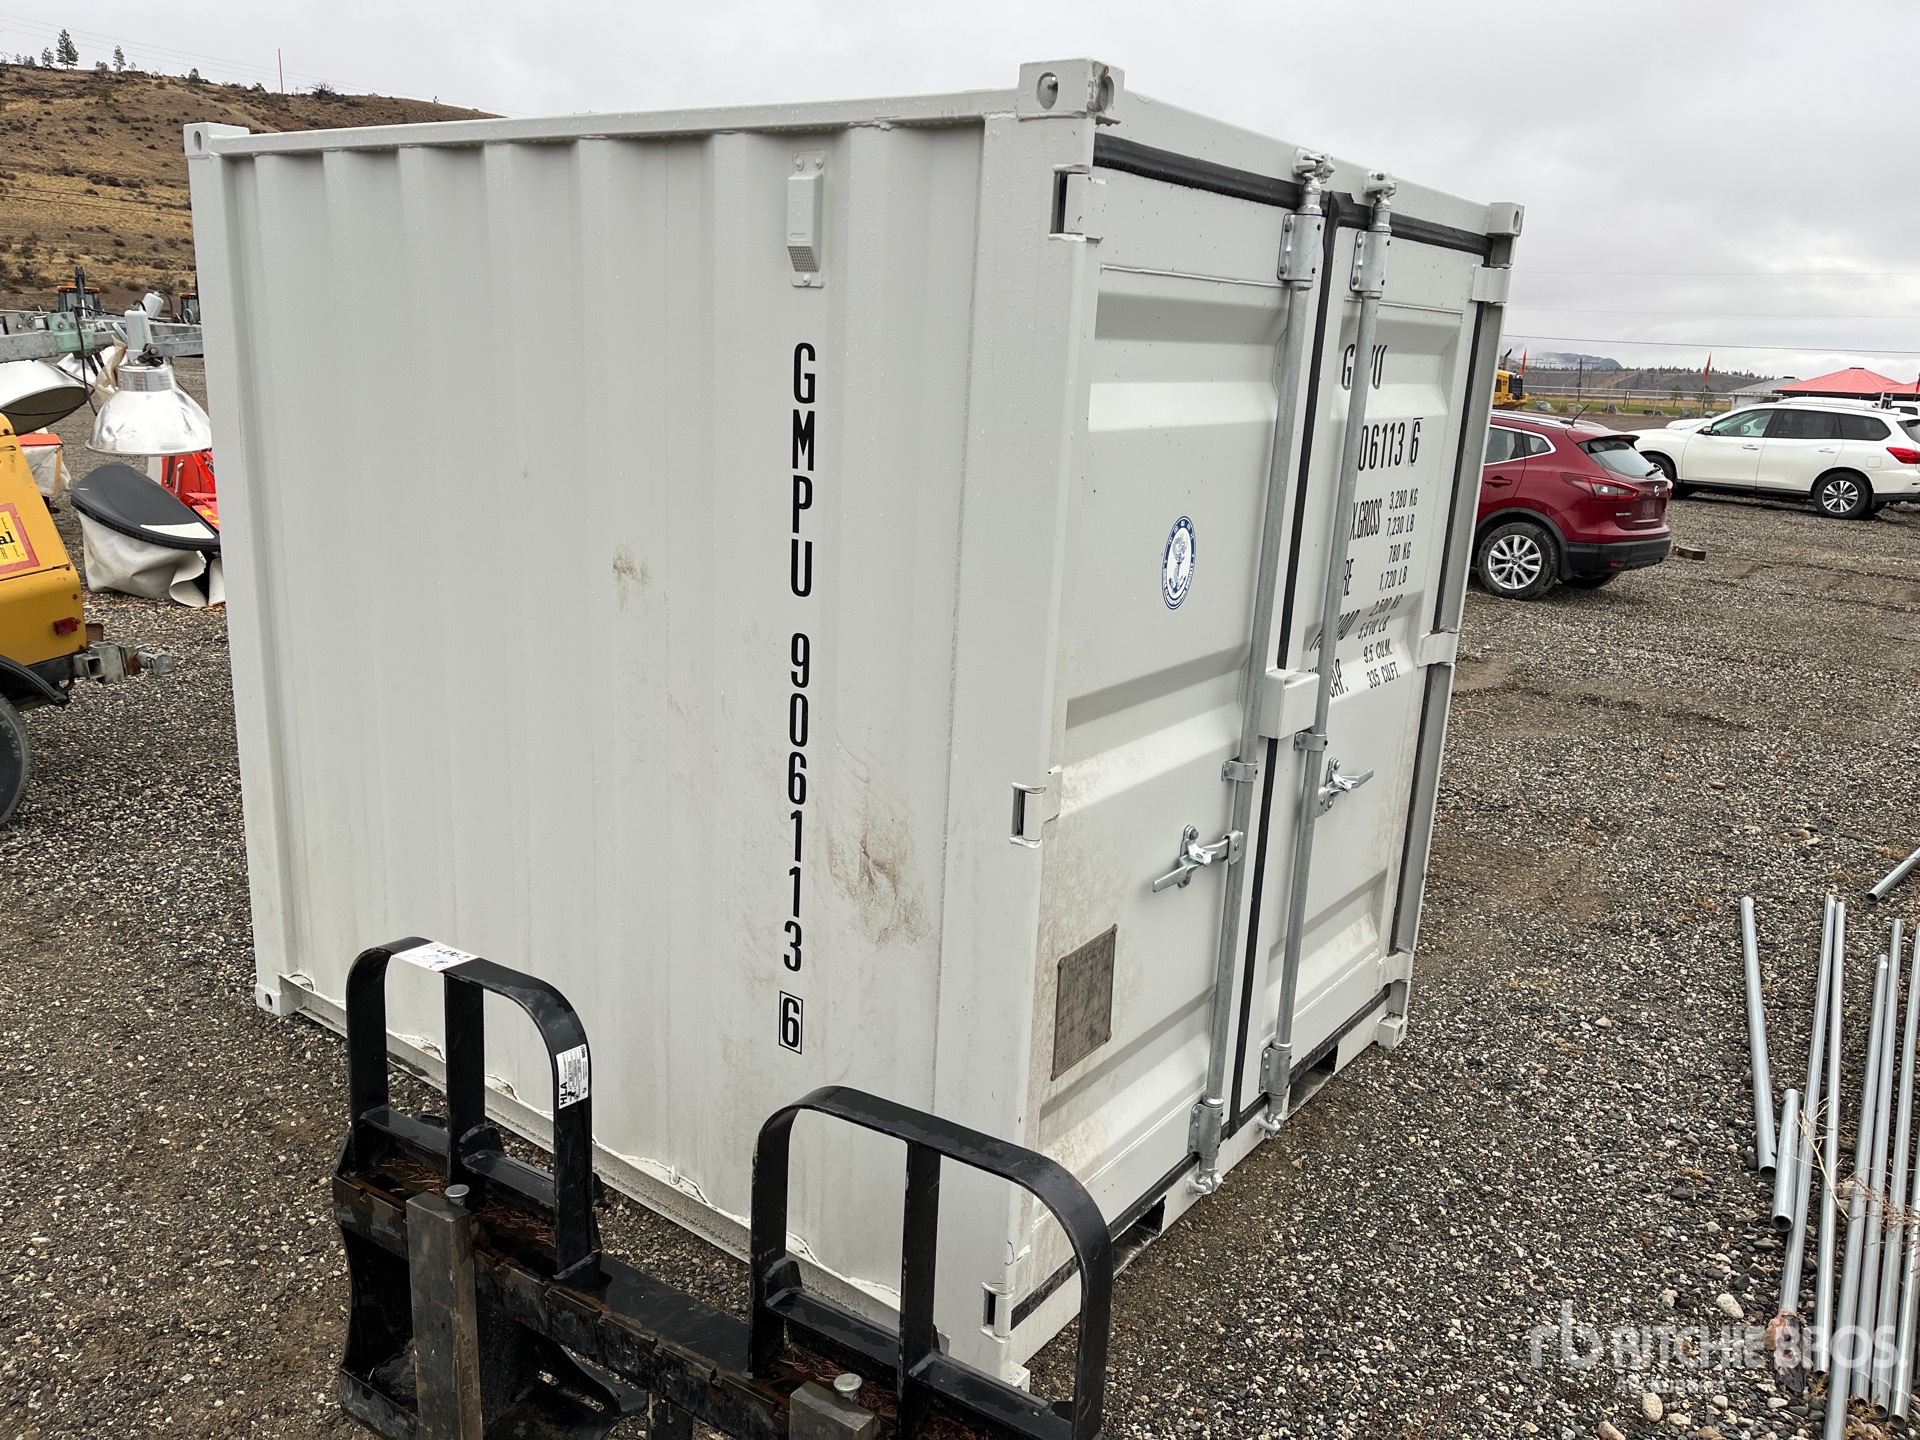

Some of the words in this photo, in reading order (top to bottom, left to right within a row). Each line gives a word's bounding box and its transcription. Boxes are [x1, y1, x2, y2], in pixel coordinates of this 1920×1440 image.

[1410, 419, 1421, 464] 6
[791, 342, 815, 597] GMPU
[1389, 489, 1408, 512] 3,280
[1409, 488, 1418, 507] KG
[1387, 515, 1405, 539] 7,230
[1406, 513, 1415, 533] LB
[1388, 543, 1401, 564] 780
[1402, 541, 1412, 560] KG
[1379, 569, 1397, 593] 1,720
[1398, 565, 1408, 586] LB
[1378, 615, 1391, 633] LB
[1363, 643, 1374, 664] 9.5
[1366, 668, 1381, 689] 335
[784, 632, 810, 972] 906113
[780, 995, 801, 1050] 6
[560, 1081, 568, 1105] HLA
